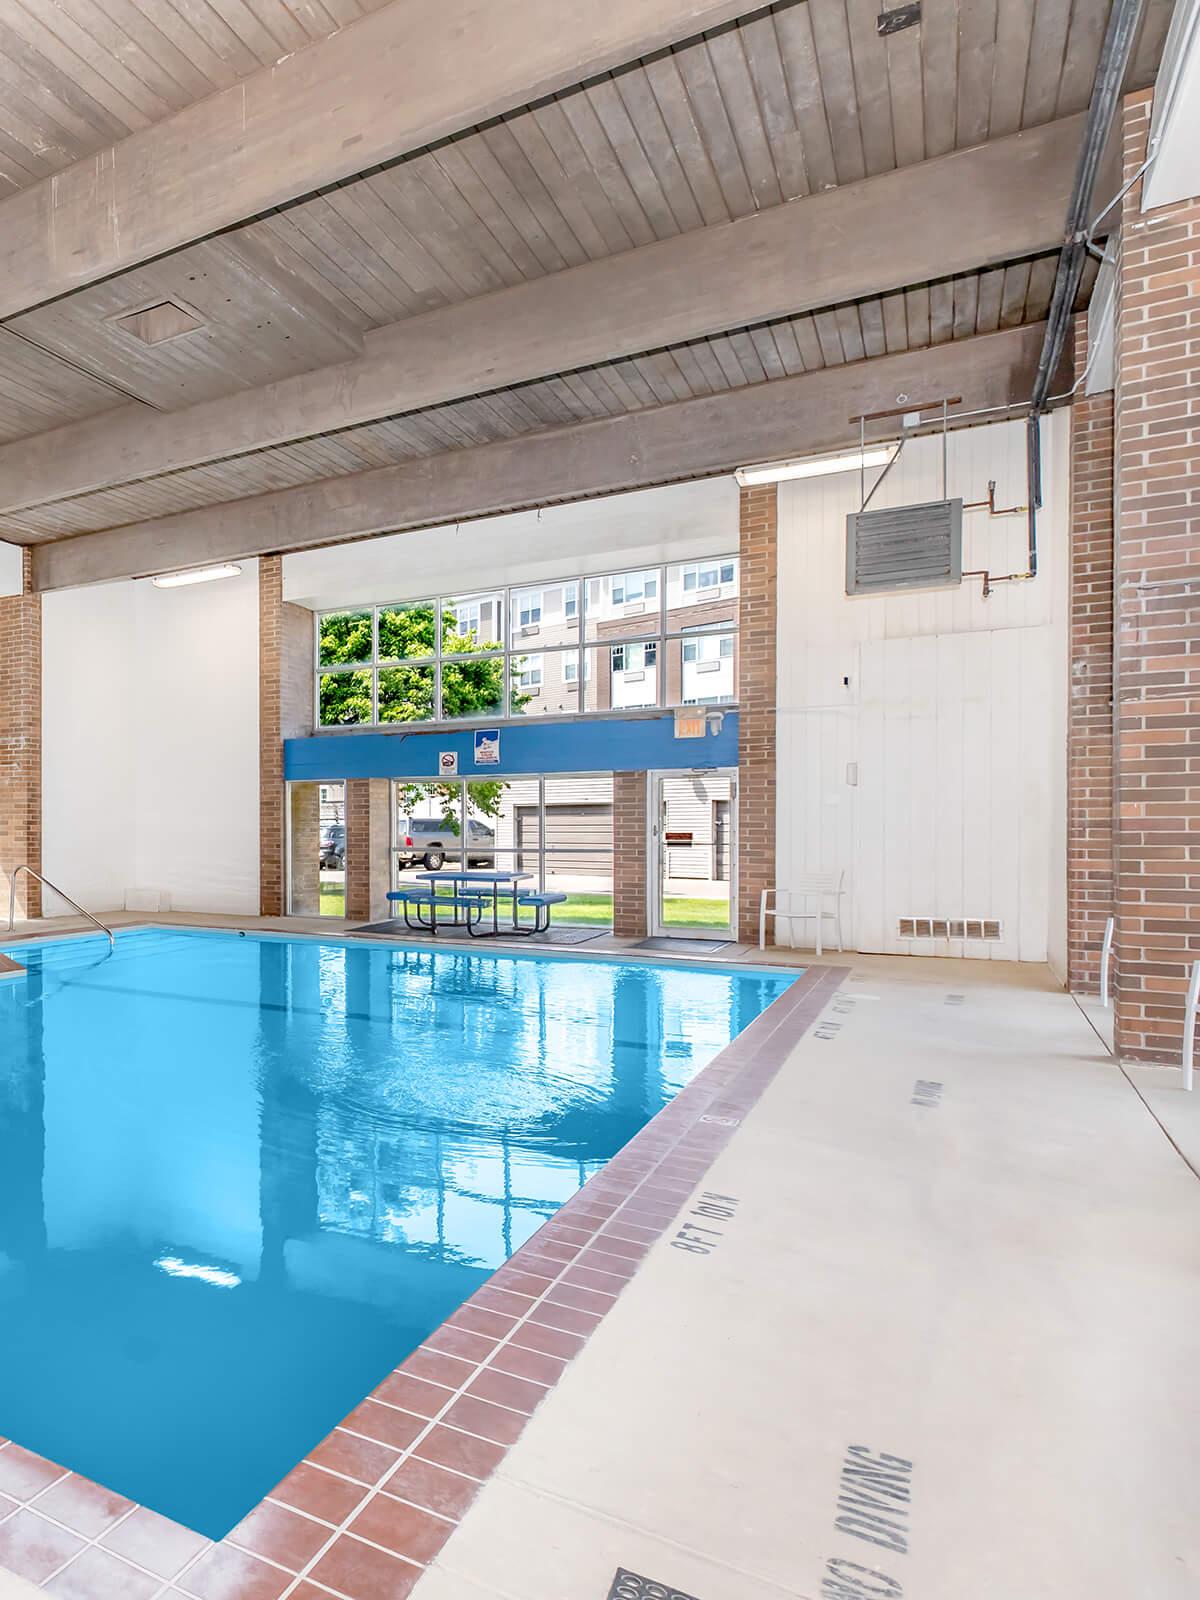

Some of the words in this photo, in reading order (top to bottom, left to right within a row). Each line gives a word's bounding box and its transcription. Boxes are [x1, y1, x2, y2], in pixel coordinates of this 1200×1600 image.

[689, 1191, 741, 1222] 10IN
[669, 1222, 724, 1255] 8FT
[833, 1445, 913, 1554] DIVING
